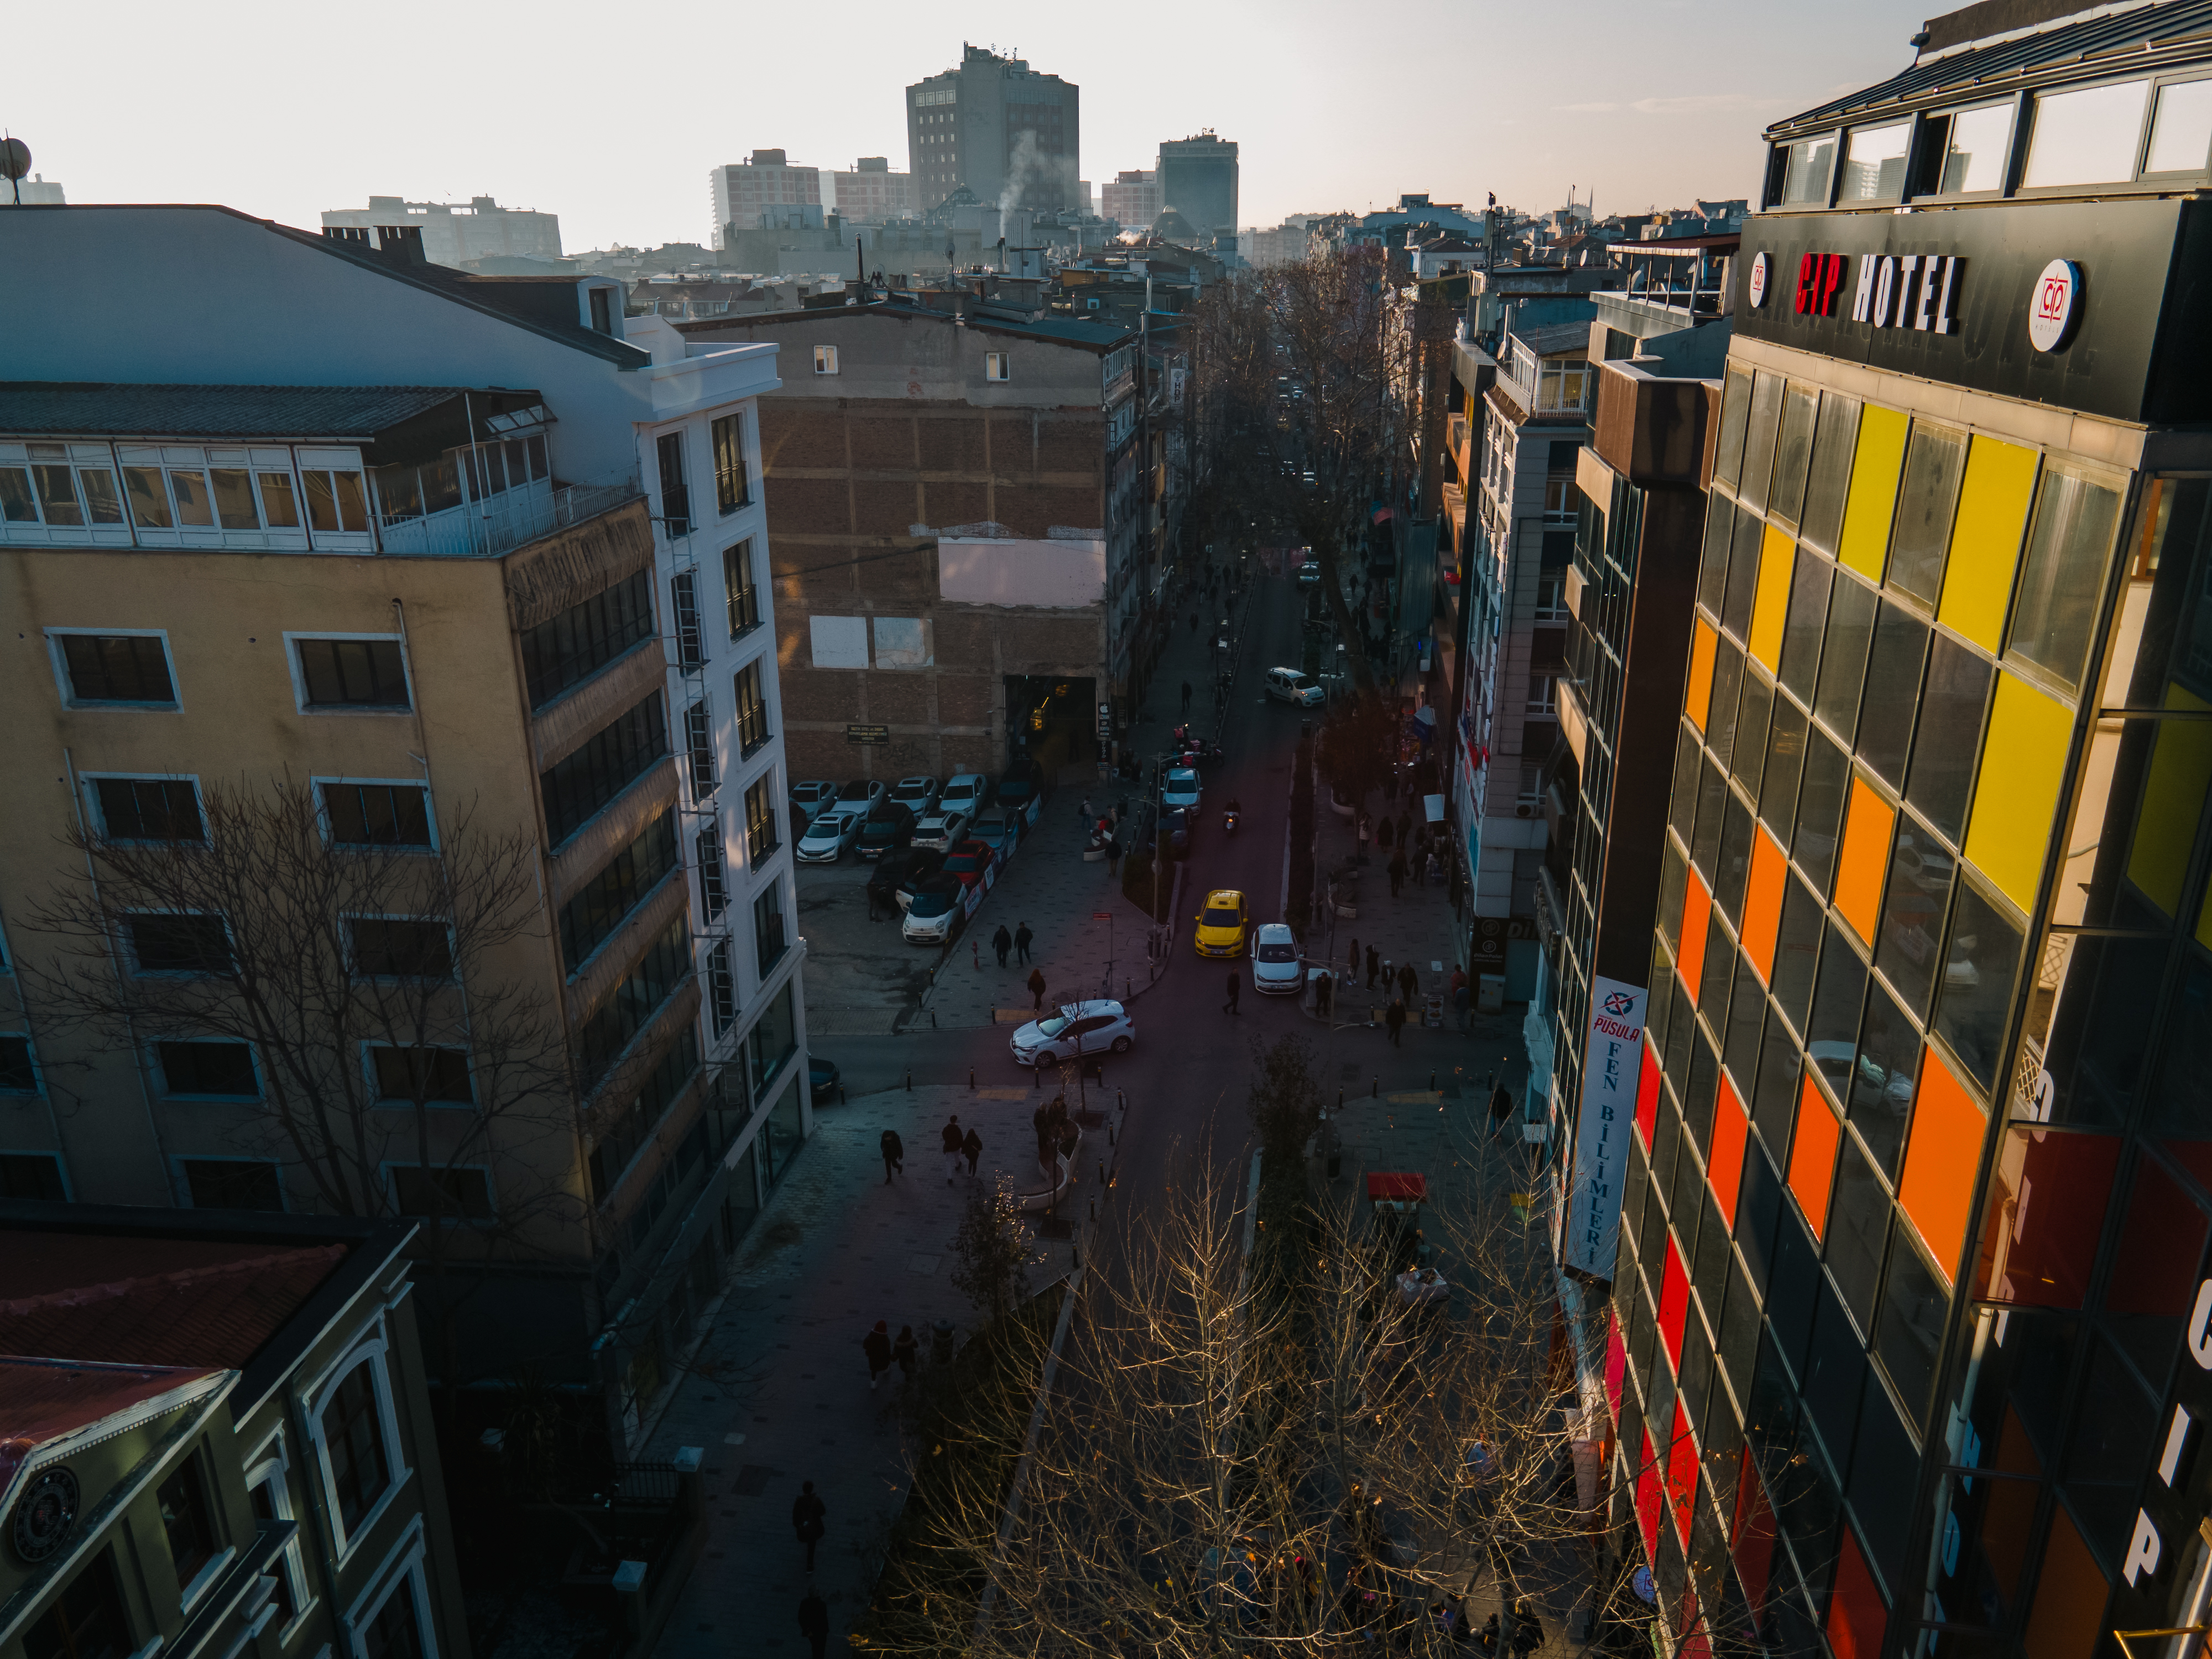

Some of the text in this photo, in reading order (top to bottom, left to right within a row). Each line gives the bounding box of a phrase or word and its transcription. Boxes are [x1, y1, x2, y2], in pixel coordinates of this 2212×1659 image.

[1796, 252, 1840, 316] CIP
[1853, 254, 1955, 334] HOTEL
[1593, 1017, 1640, 1042] PUSULA
[1603, 1041, 1621, 1092] FEN
